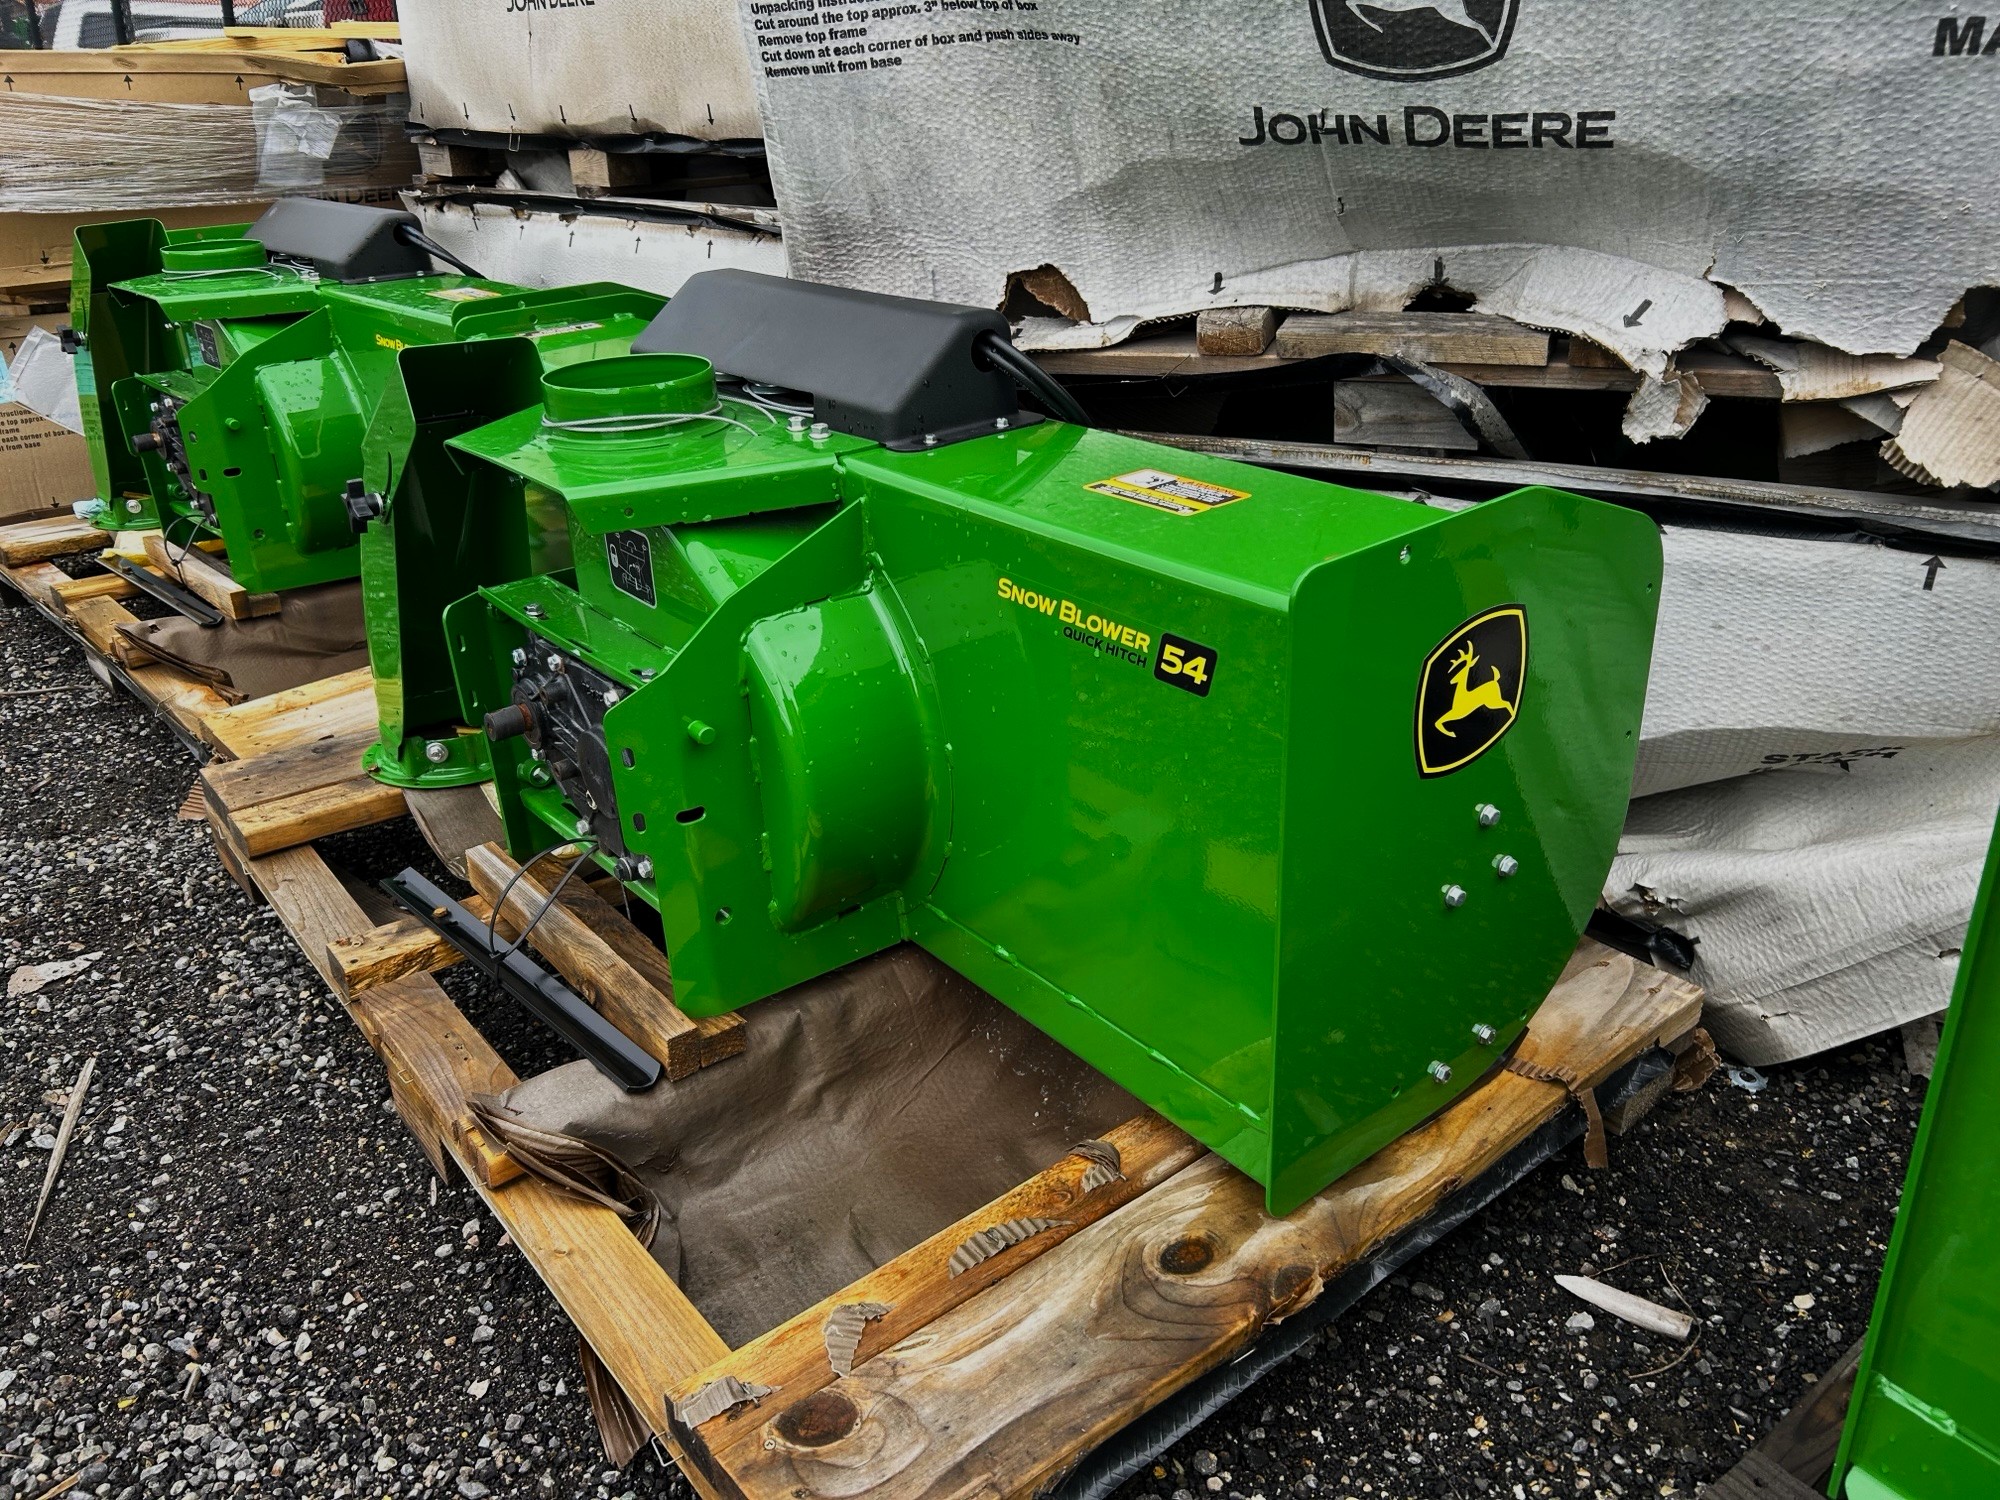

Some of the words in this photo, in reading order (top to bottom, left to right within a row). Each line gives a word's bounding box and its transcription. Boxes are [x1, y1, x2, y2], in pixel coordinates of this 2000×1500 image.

[751, 0, 815, 16] Unpacking
[754, 18, 776, 31] Cut
[777, 13, 819, 28] around
[822, 11, 844, 25] the
[846, 9, 869, 22] top
[871, 4, 921, 20] approx.
[941, 0, 978, 11] below
[980, 0, 1000, 11] top
[1001, 0, 1015, 10] of
[1016, 0, 1039, 11] box
[757, 33, 803, 47] Remove
[805, 31, 827, 44] top
[828, 27, 868, 41] frame
[761, 50, 783, 63] Cut
[784, 48, 815, 61] down
[818, 45, 831, 58] at
[833, 42, 866, 57] each
[867, 38, 912, 52] corner
[915, 34, 928, 47] of
[931, 33, 956, 46] box
[958, 30, 983, 43] and
[984, 29, 1015, 43] push
[1016, 29, 1049, 41] sides
[1050, 32, 1081, 46] away
[764, 64, 810, 78] Remove
[812, 62, 836, 75] unit
[837, 60, 868, 72] from
[870, 56, 903, 69] base
[1238, 106, 1391, 147] JOHN
[1403, 105, 1616, 149] DEERE
[2, 435, 19, 443] each
[20, 432, 42, 441] corner
[5, 443, 23, 451] from
[24, 441, 41, 449] base
[997, 577, 1058, 616] SNOW
[1058, 599, 1151, 653] BLOWER
[1062, 626, 1104, 651] QUICK
[1104, 643, 1148, 669] HITCH
[1160, 643, 1208, 685] 54
